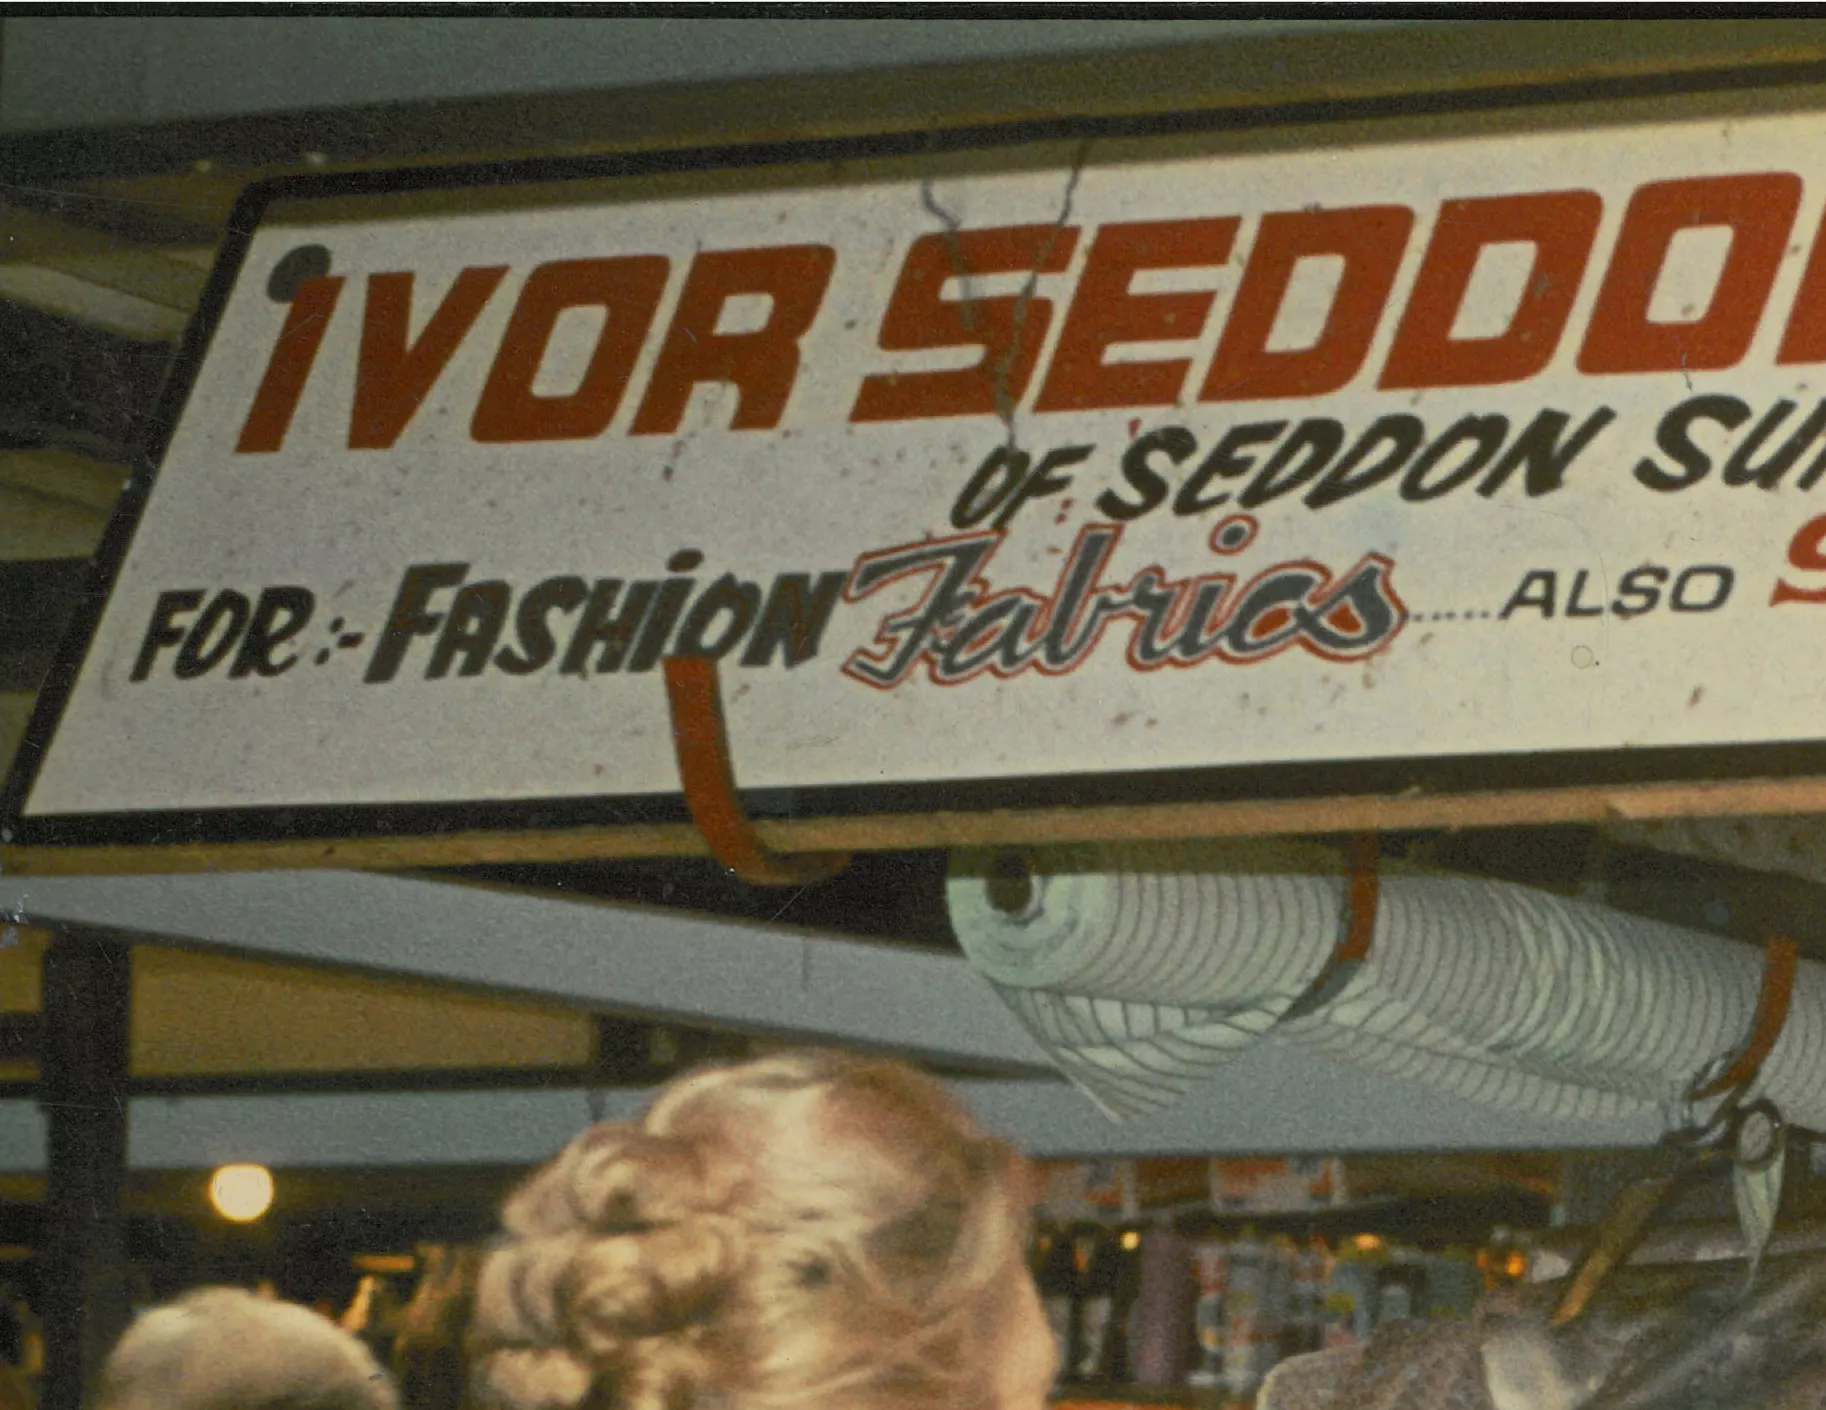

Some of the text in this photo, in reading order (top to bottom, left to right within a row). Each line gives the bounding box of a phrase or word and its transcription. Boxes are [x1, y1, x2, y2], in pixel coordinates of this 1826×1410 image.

[951, 443, 1096, 529] OF
[1095, 405, 1617, 522] SEDDON
[364, 549, 848, 686] FASHION
[1500, 564, 1735, 621] ALSO
